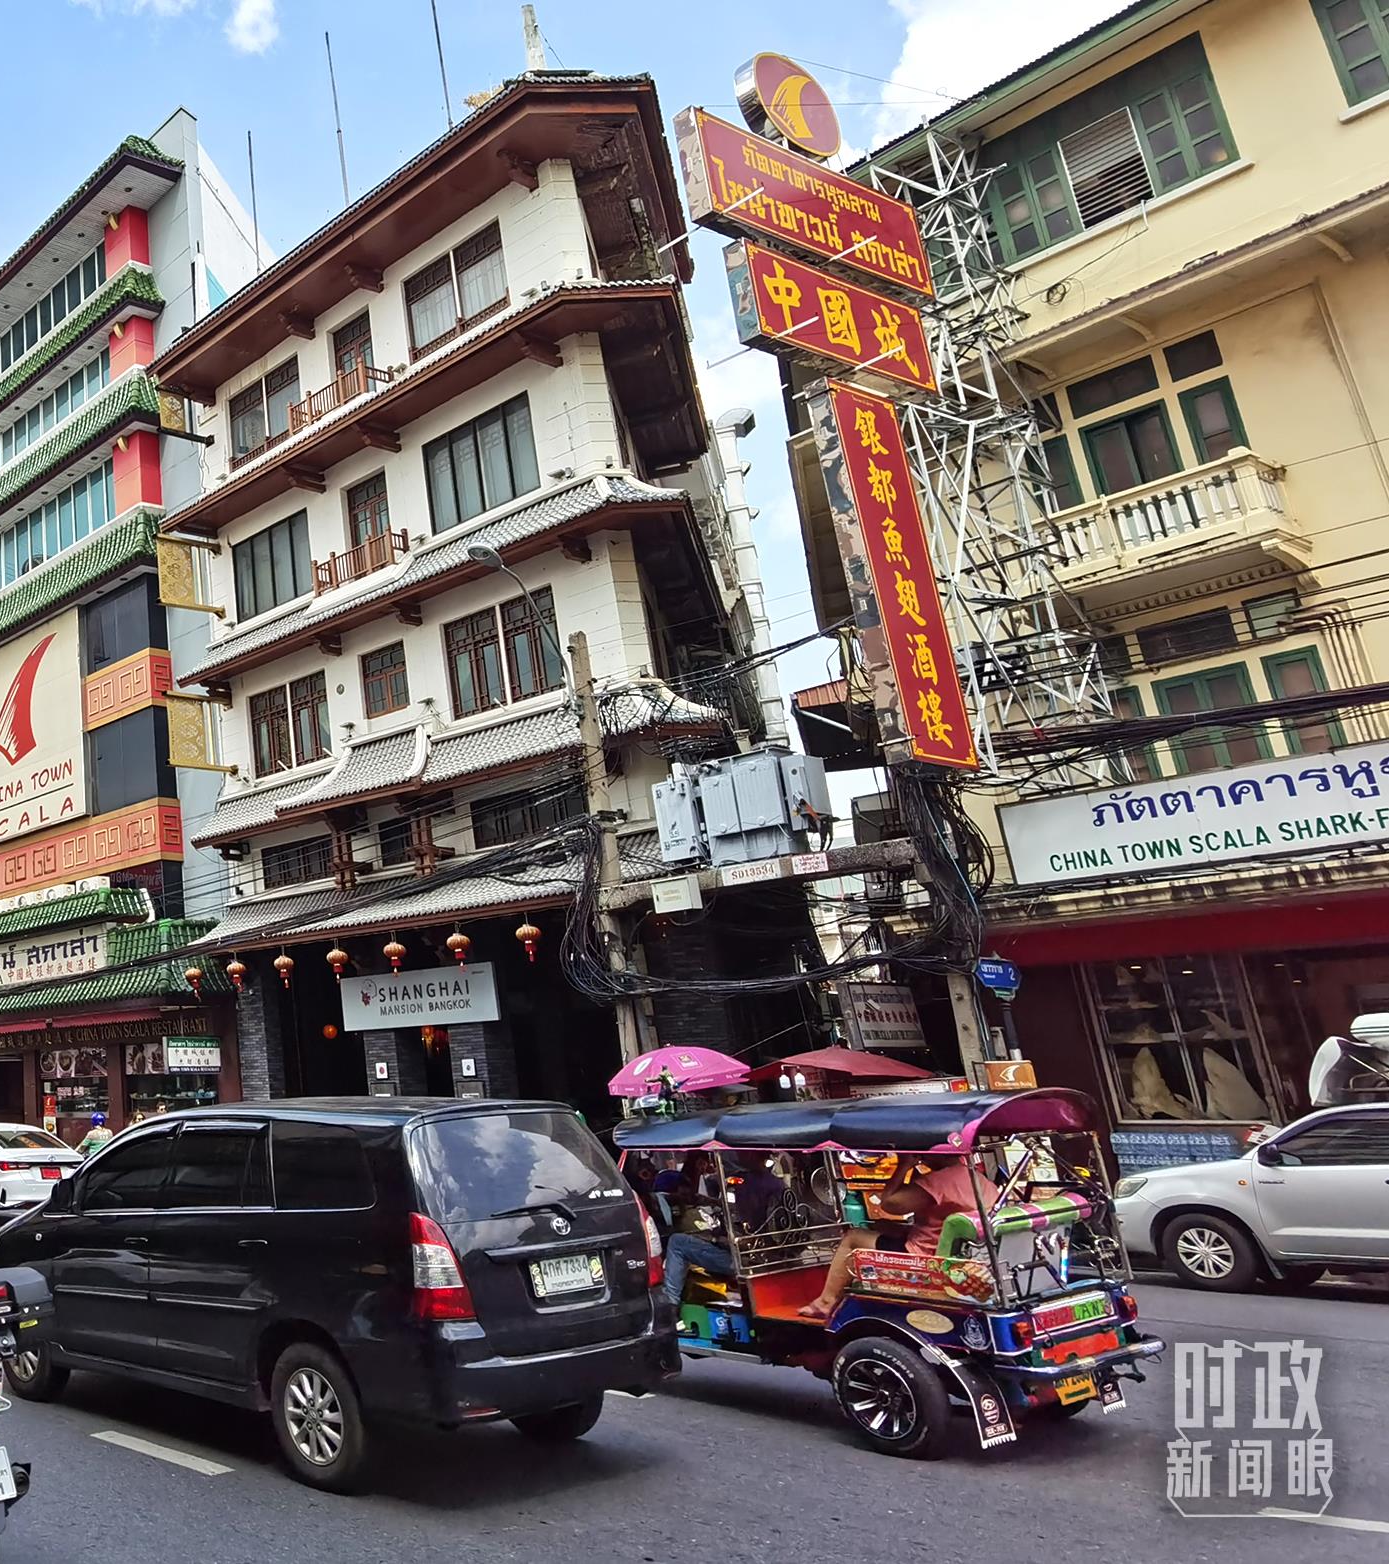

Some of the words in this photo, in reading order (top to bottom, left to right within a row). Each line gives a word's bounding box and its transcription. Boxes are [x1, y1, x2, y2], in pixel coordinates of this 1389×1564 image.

[742, 139, 882, 225] ภัตตาคารหูฉลาม
[762, 258, 920, 379] 中國城
[853, 406, 954, 750] 銀都魚翅酒樓
[30, 758, 74, 790] TOWN
[1049, 845, 1113, 872] CHINA
[1117, 837, 1183, 864] TOWN
[1189, 826, 1271, 854] SCALA
[731, 865, 775, 881] SD13534
[26, 929, 100, 966] สกาล่า
[378, 979, 471, 1003] SHANGHAI
[380, 1003, 423, 1017] MANSION
[429, 998, 472, 1012] BANGKOK
[76, 1027, 100, 1042] CHINA
[100, 1024, 124, 1041] TOWN
[124, 1022, 150, 1038] SCALA
[151, 1017, 208, 1037] RESTAURANT
[565, 1258, 589, 1274] 7334
